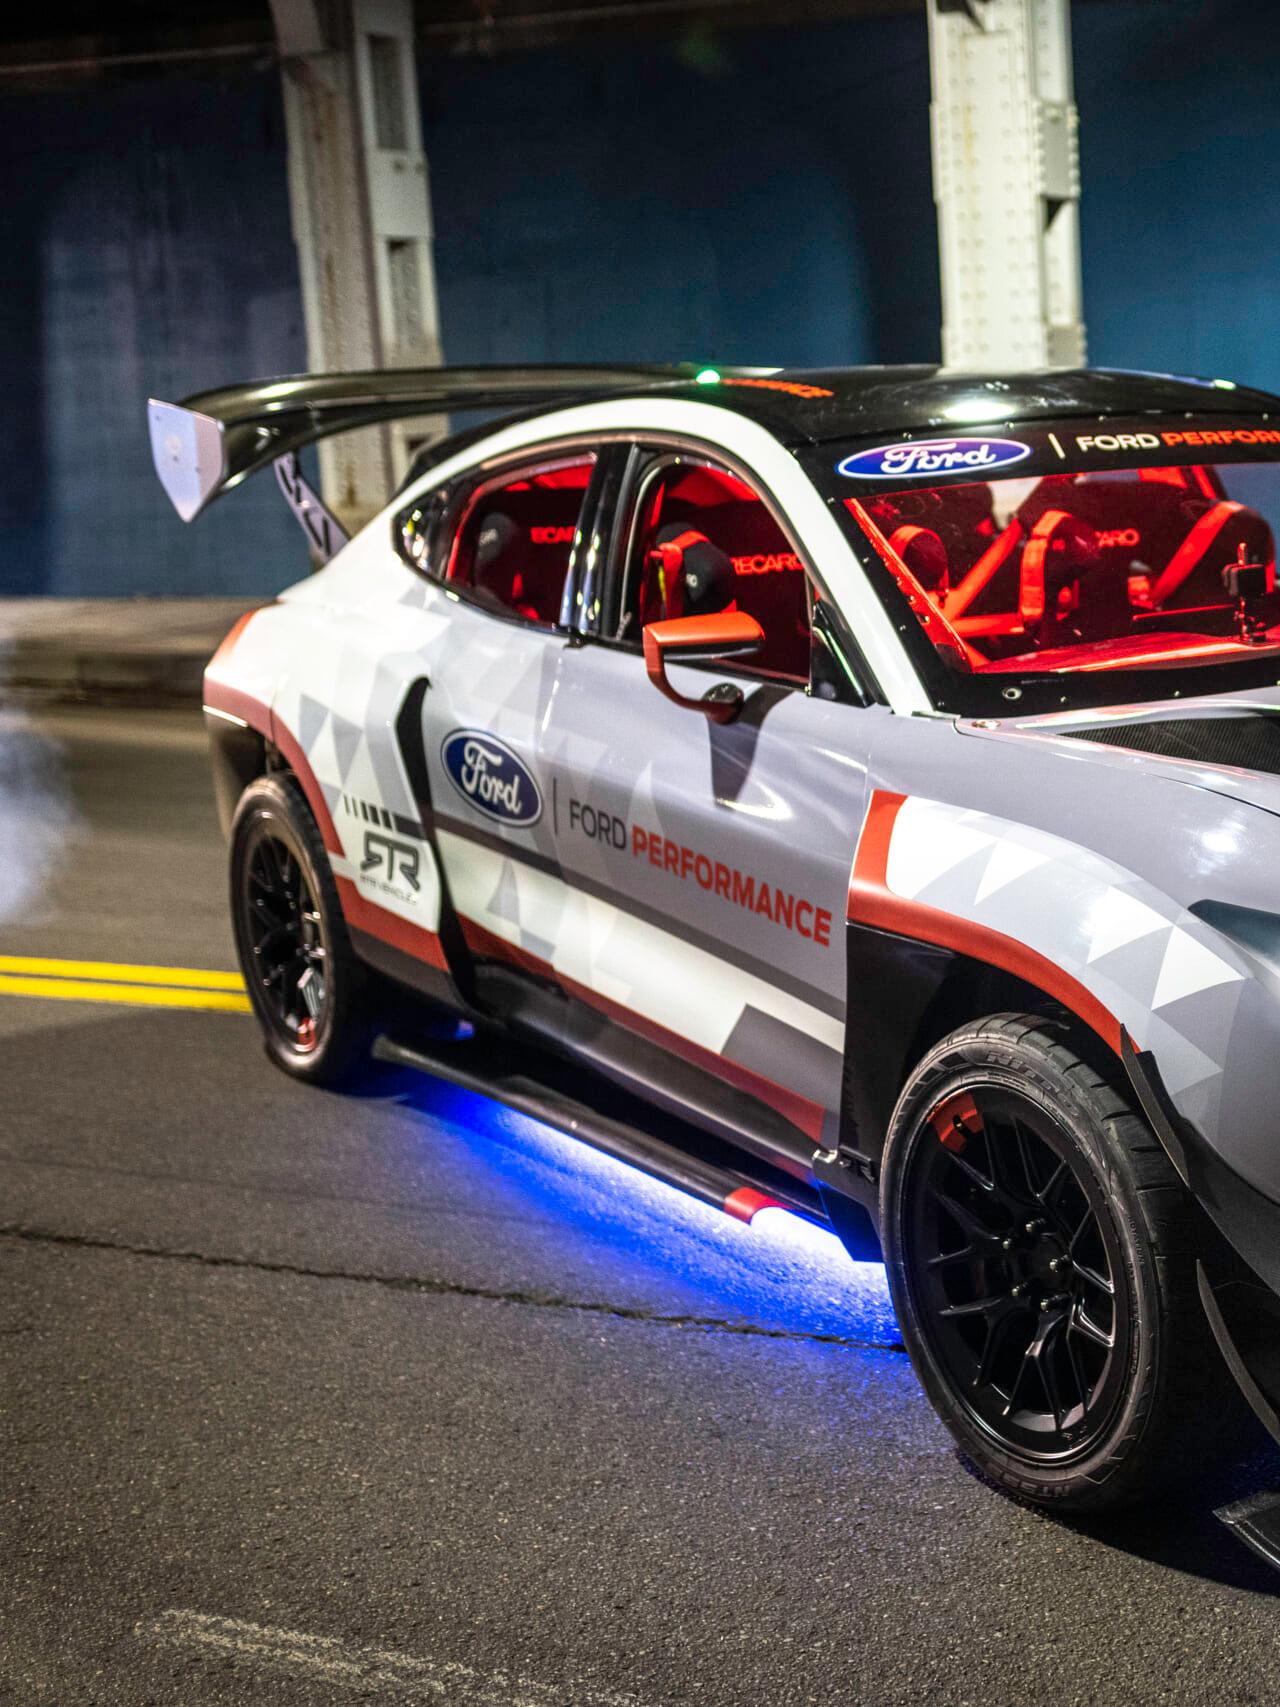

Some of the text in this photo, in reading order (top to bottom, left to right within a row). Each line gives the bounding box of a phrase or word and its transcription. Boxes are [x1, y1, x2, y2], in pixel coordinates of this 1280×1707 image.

[880, 442, 997, 474] Ford
[1075, 432, 1161, 452] FORD
[460, 740, 523, 815] Ford
[360, 830, 421, 892] RTR
[569, 798, 833, 949] FORD PERFORMANCE
